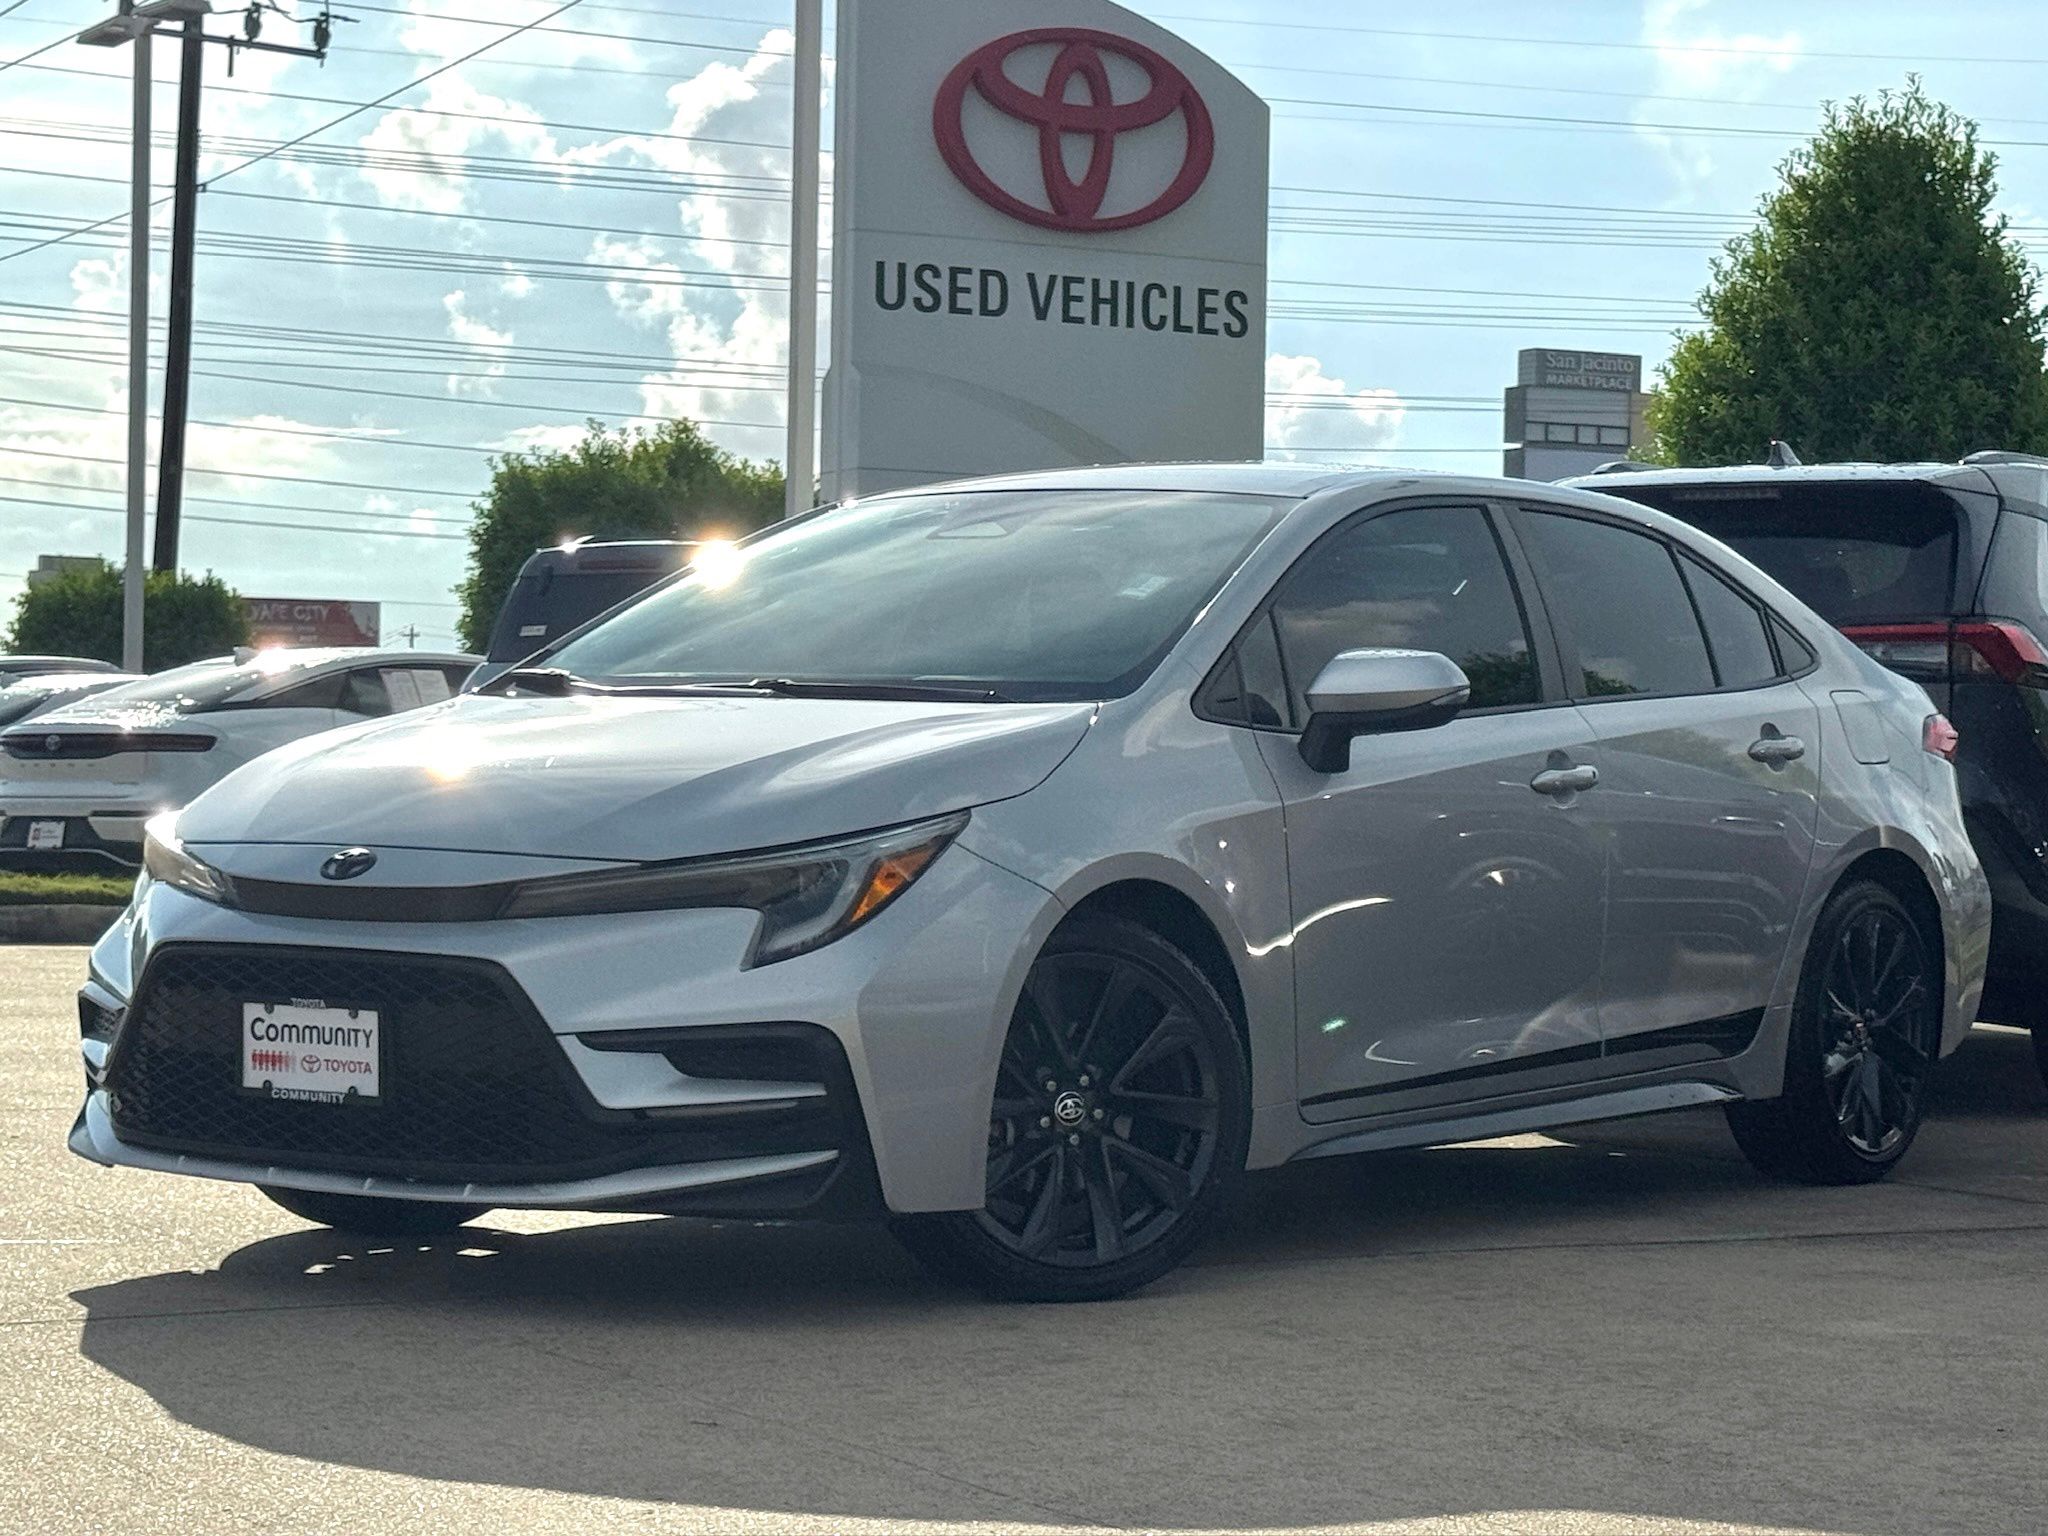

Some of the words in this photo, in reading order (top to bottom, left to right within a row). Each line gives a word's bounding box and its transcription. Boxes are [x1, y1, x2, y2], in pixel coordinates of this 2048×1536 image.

[874, 260, 1009, 317] USED
[1026, 272, 1249, 338] VEHICLES
[1545, 352, 1575, 369] San
[1577, 353, 1634, 374] Jacinto
[1545, 374, 1633, 390] MARKETPLACE
[323, 1058, 373, 1075] TOYOTA
[271, 1088, 346, 1104] COMMUNITY
